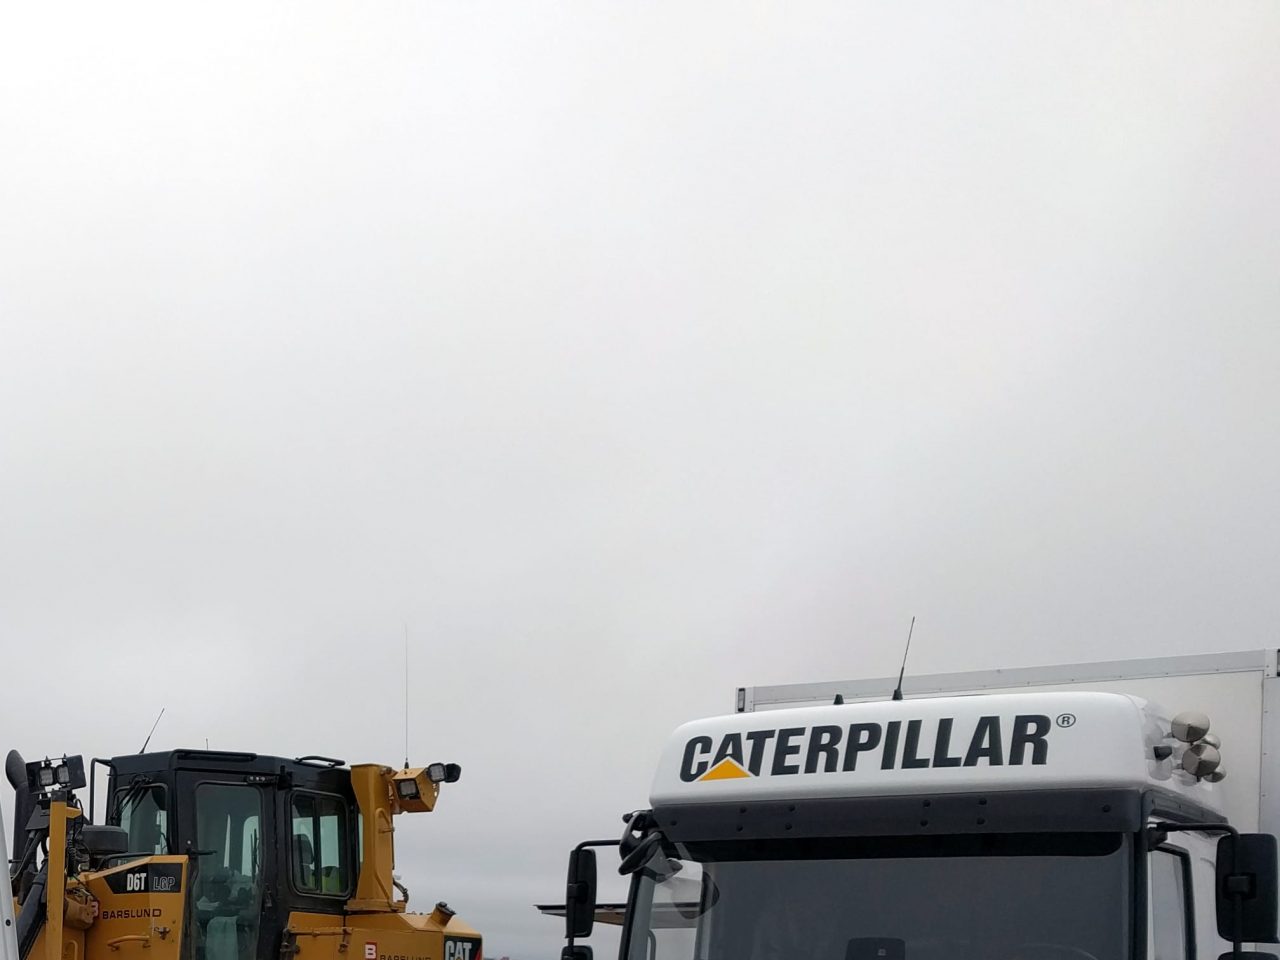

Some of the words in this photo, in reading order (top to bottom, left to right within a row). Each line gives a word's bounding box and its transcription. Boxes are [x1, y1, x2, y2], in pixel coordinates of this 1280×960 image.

[126, 873, 147, 891] D6T
[153, 876, 176, 891] LGP
[102, 908, 161, 919] BARSLUND
